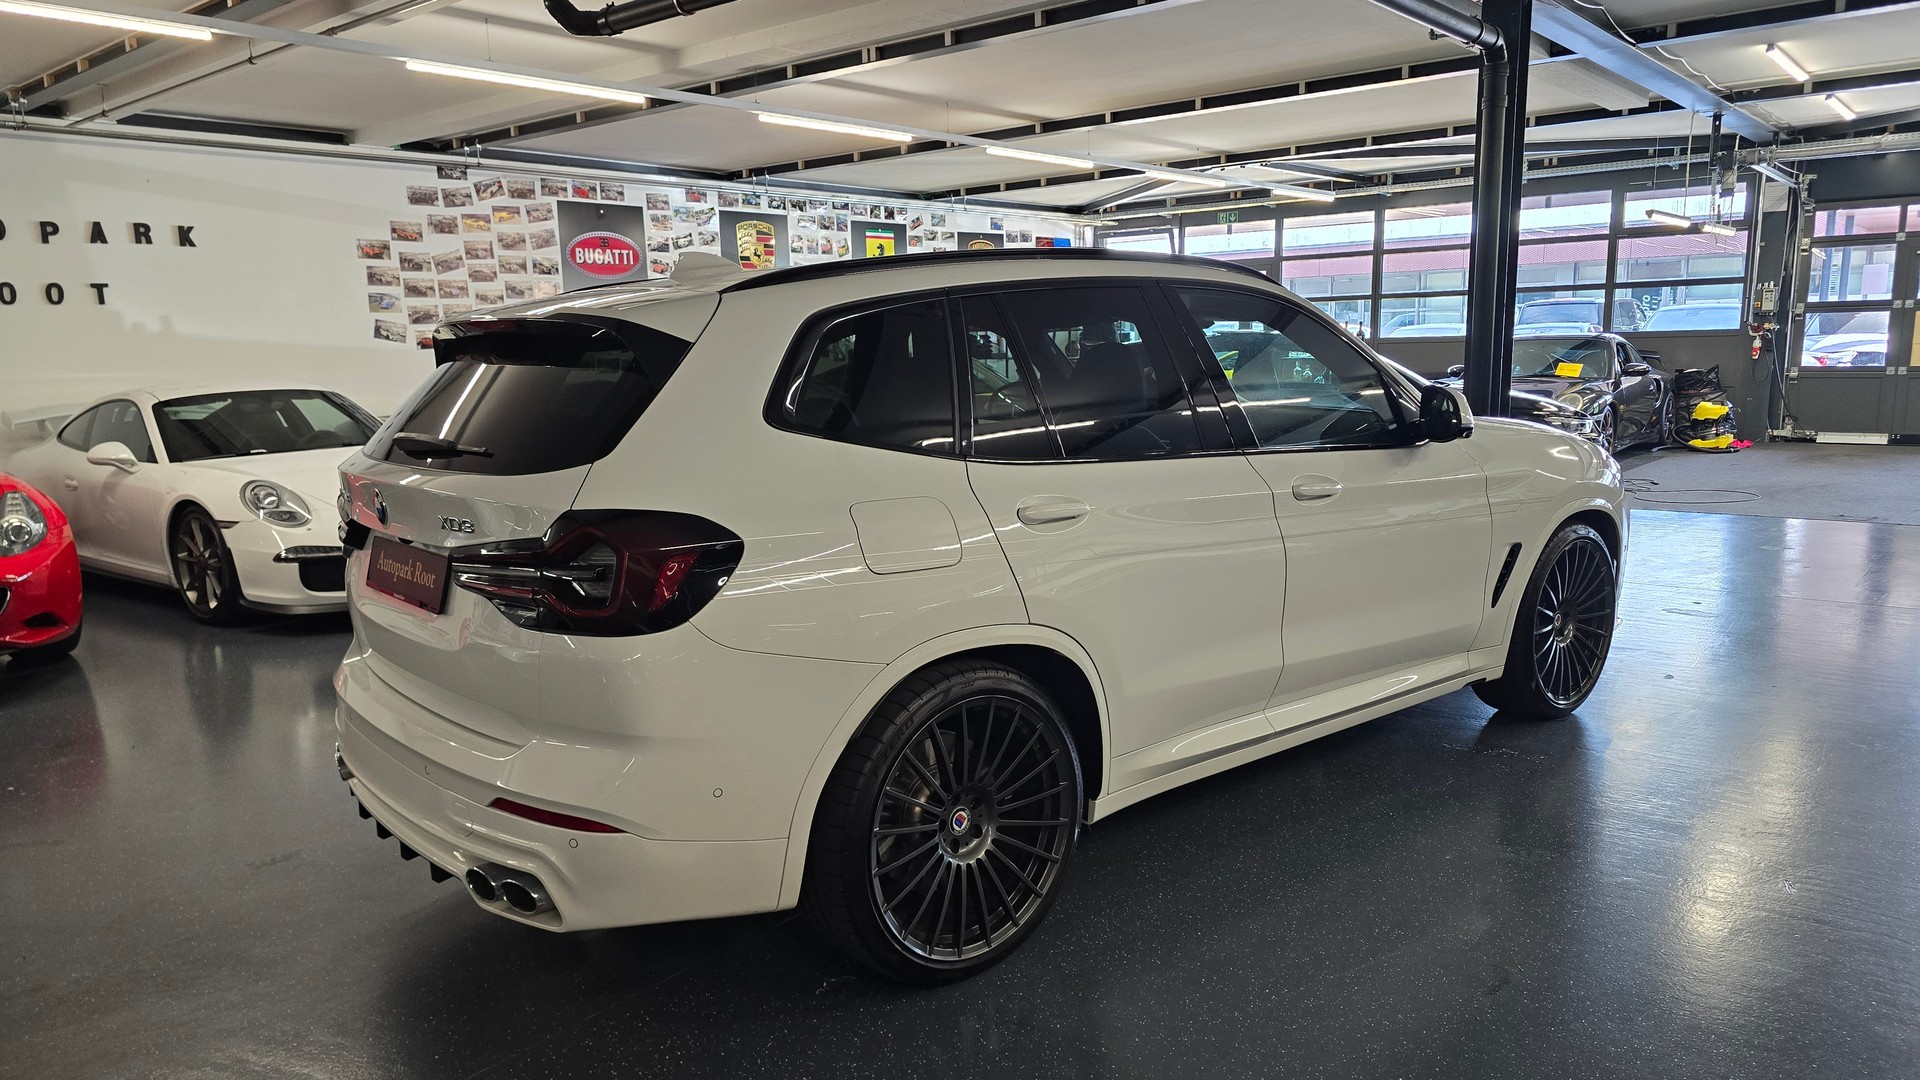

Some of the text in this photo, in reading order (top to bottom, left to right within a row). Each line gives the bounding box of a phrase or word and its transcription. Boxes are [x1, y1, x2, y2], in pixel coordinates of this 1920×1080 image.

[737, 223, 773, 233] PORSCHE
[575, 247, 634, 265] BUGATTI
[438, 515, 475, 533] XD3
[377, 550, 436, 588] Autopark Root
